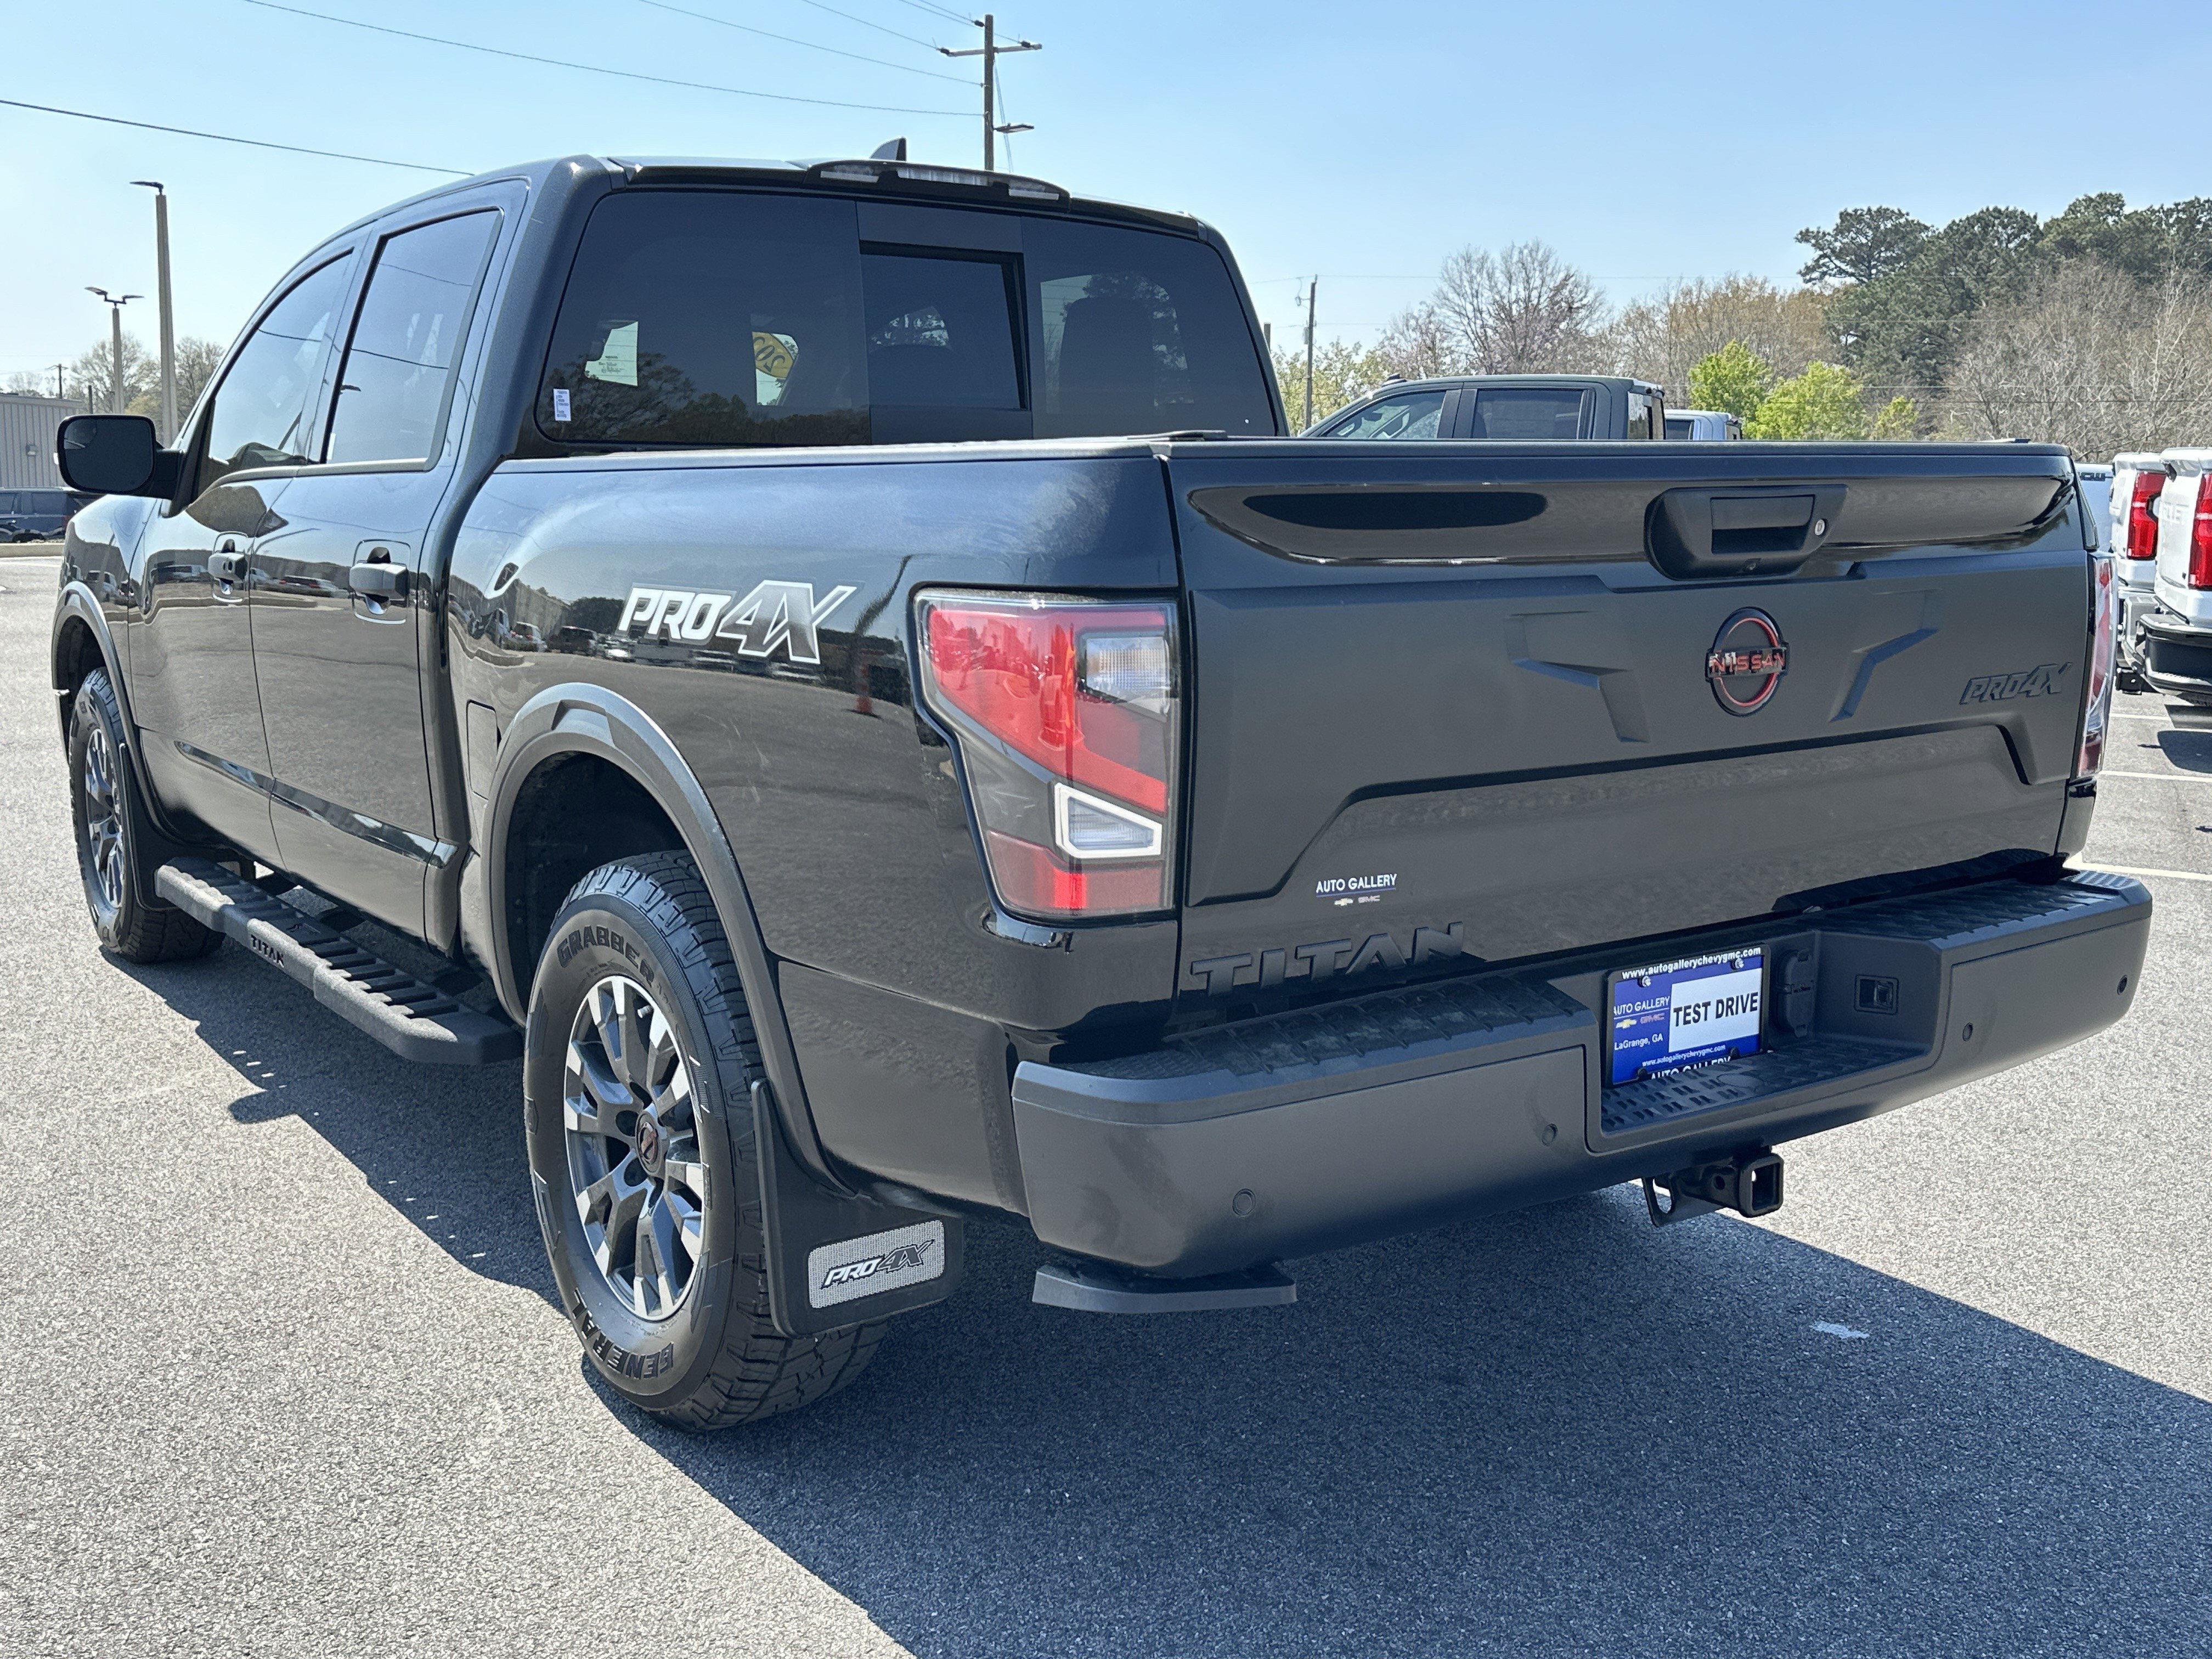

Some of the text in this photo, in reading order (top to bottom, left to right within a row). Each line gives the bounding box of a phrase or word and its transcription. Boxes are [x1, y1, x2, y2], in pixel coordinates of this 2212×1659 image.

[617, 579, 859, 664] PRO4X
[1708, 651, 1785, 674] NISSAN
[1959, 661, 2073, 705] PRO4X
[1316, 873, 1398, 893] AUTO GALLERY
[1358, 895, 1380, 904] GMC
[251, 934, 285, 968] TITAN
[556, 924, 655, 988] GRABBER
[1190, 921, 1464, 996] TITAN
[1622, 947, 1761, 980] www.autogallerychevygmc.com
[1613, 996, 1671, 1015] AUTO GALLERY
[1673, 991, 1759, 1027] TEST DRIVE
[1614, 1034, 1663, 1051] LaGrange, GA
[821, 1239, 935, 1289] PRO4X
[572, 1287, 675, 1380] GENERAL
